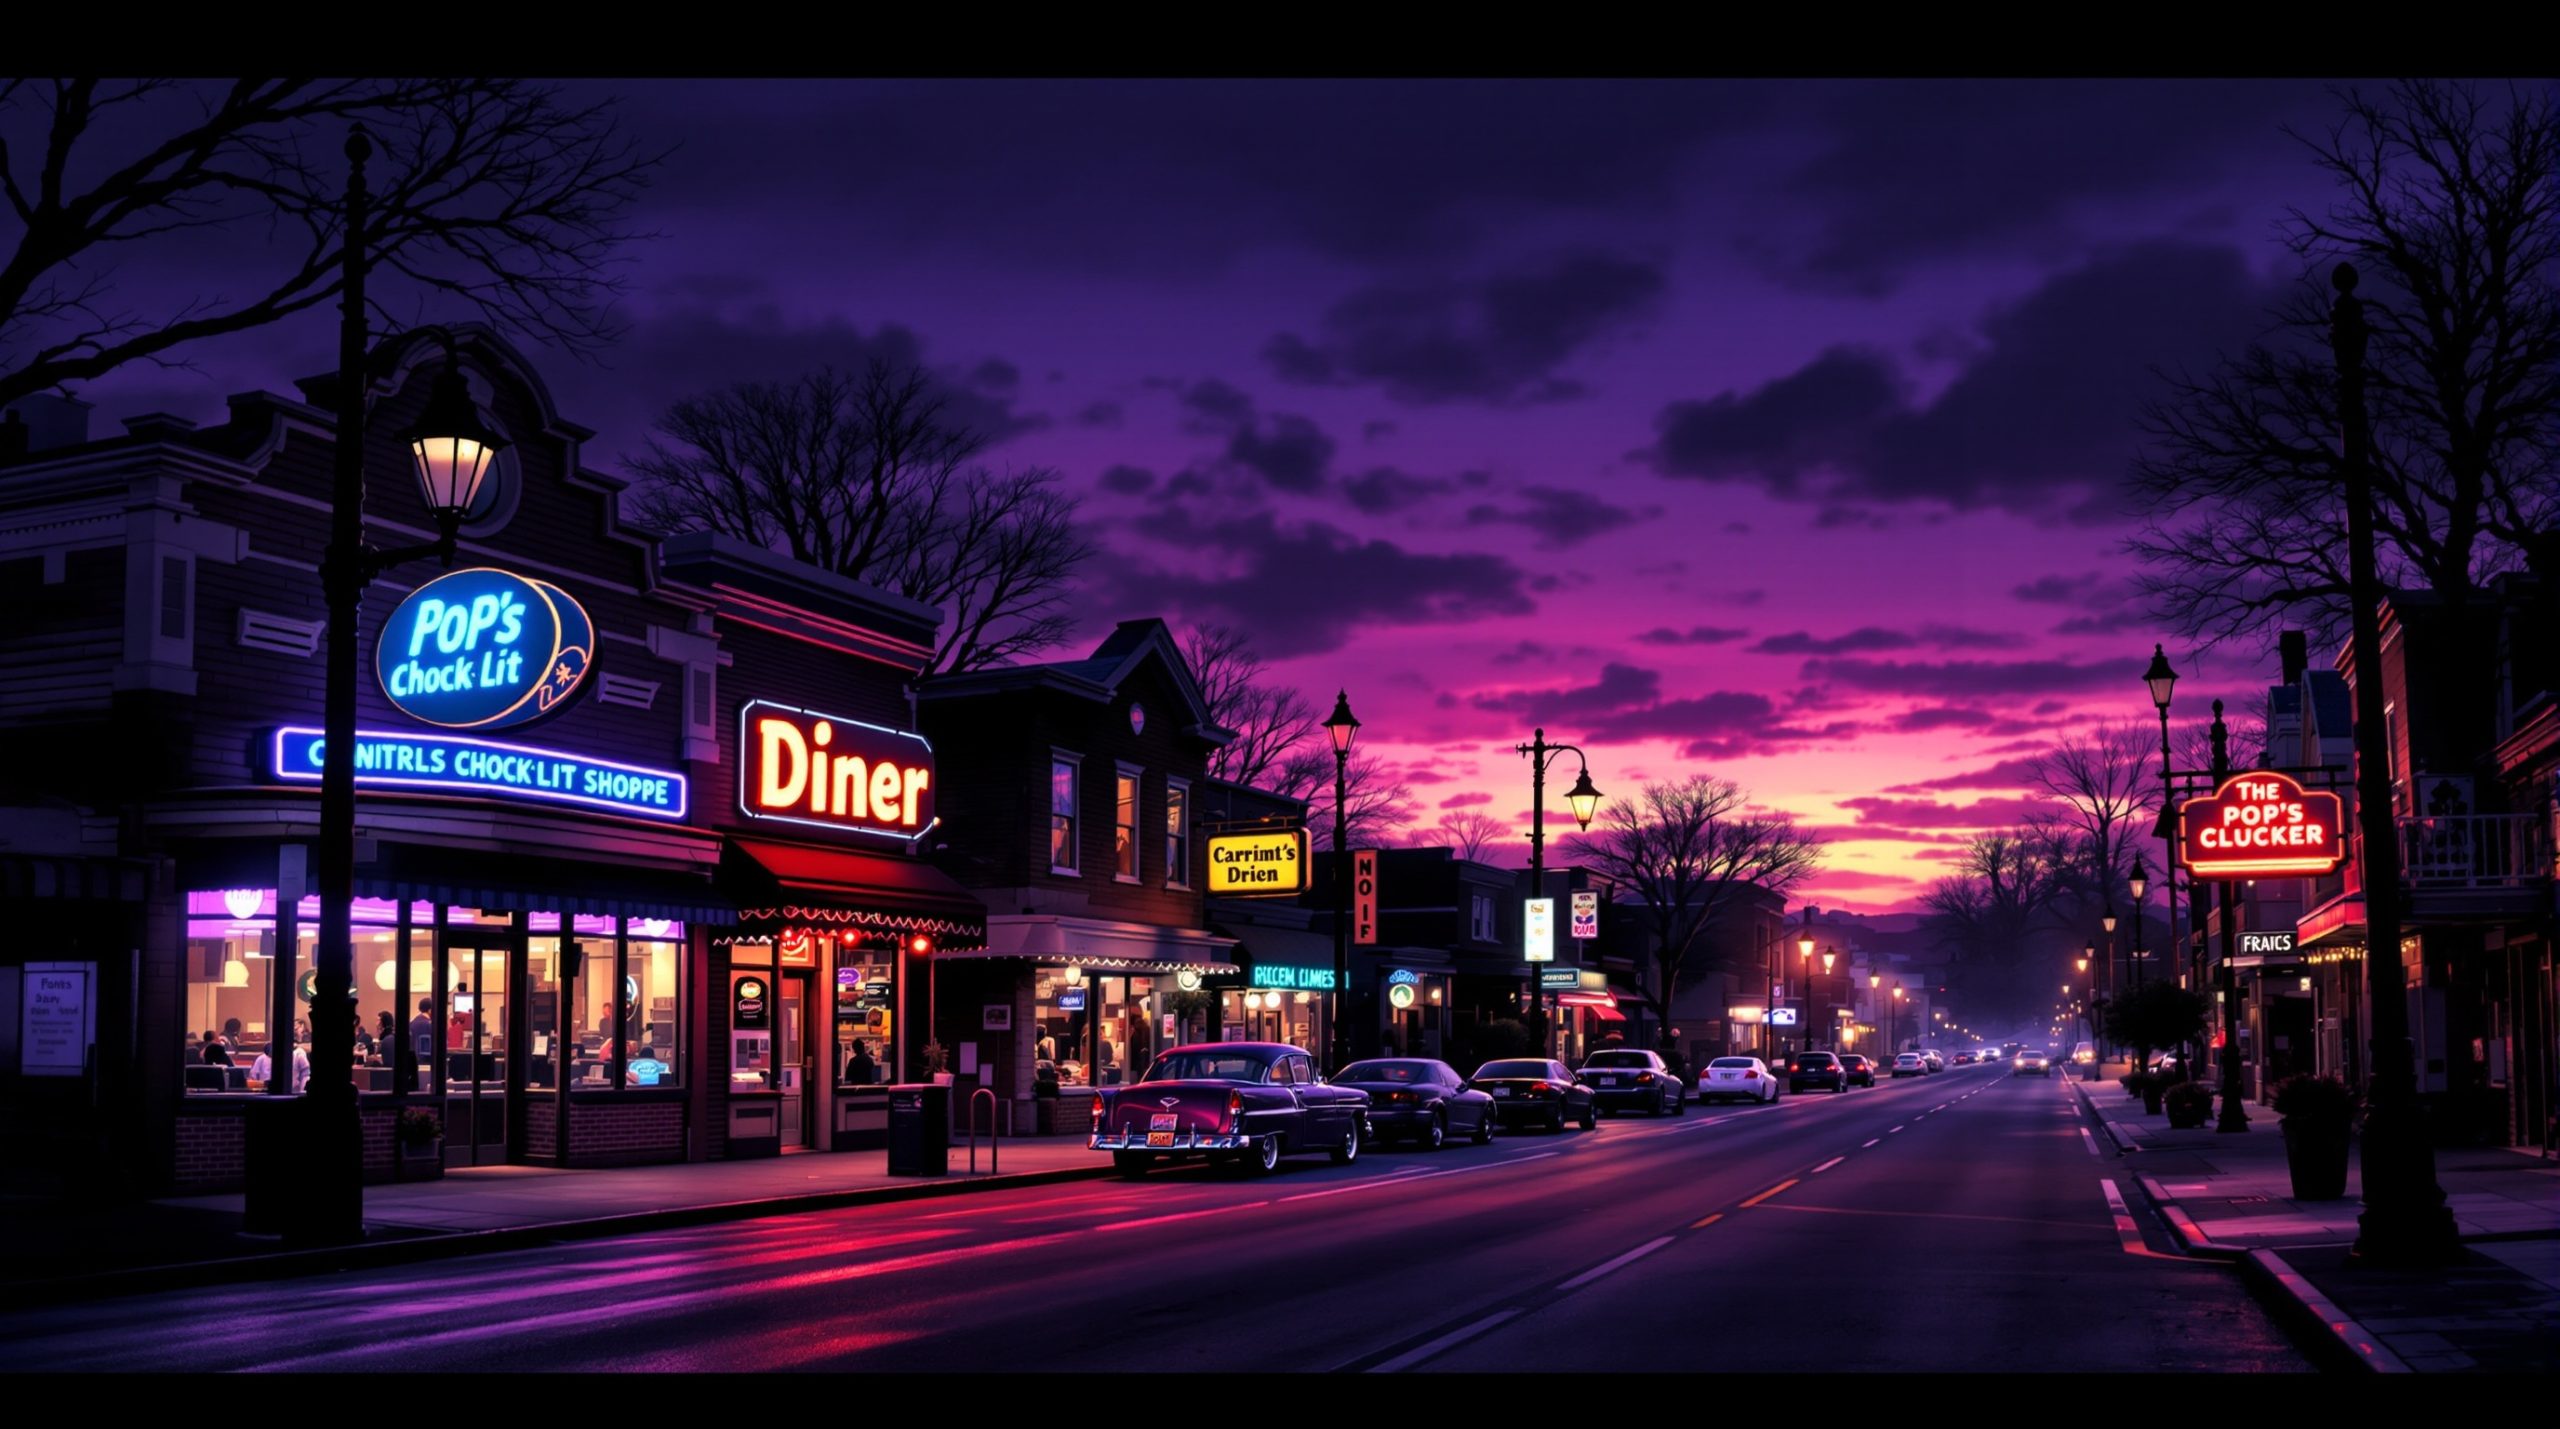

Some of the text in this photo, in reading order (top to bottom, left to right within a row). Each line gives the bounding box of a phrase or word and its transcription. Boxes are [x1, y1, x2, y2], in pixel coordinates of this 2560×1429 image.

[308, 739, 446, 773] CNITRLS
[583, 773, 669, 804] SHOPPE
[760, 719, 929, 825] Diner
[2236, 782, 2280, 800] THE
[2224, 803, 2304, 826] POP'S
[2200, 824, 2323, 848] CLUCKER
[2243, 935, 2291, 952] FRAICS
